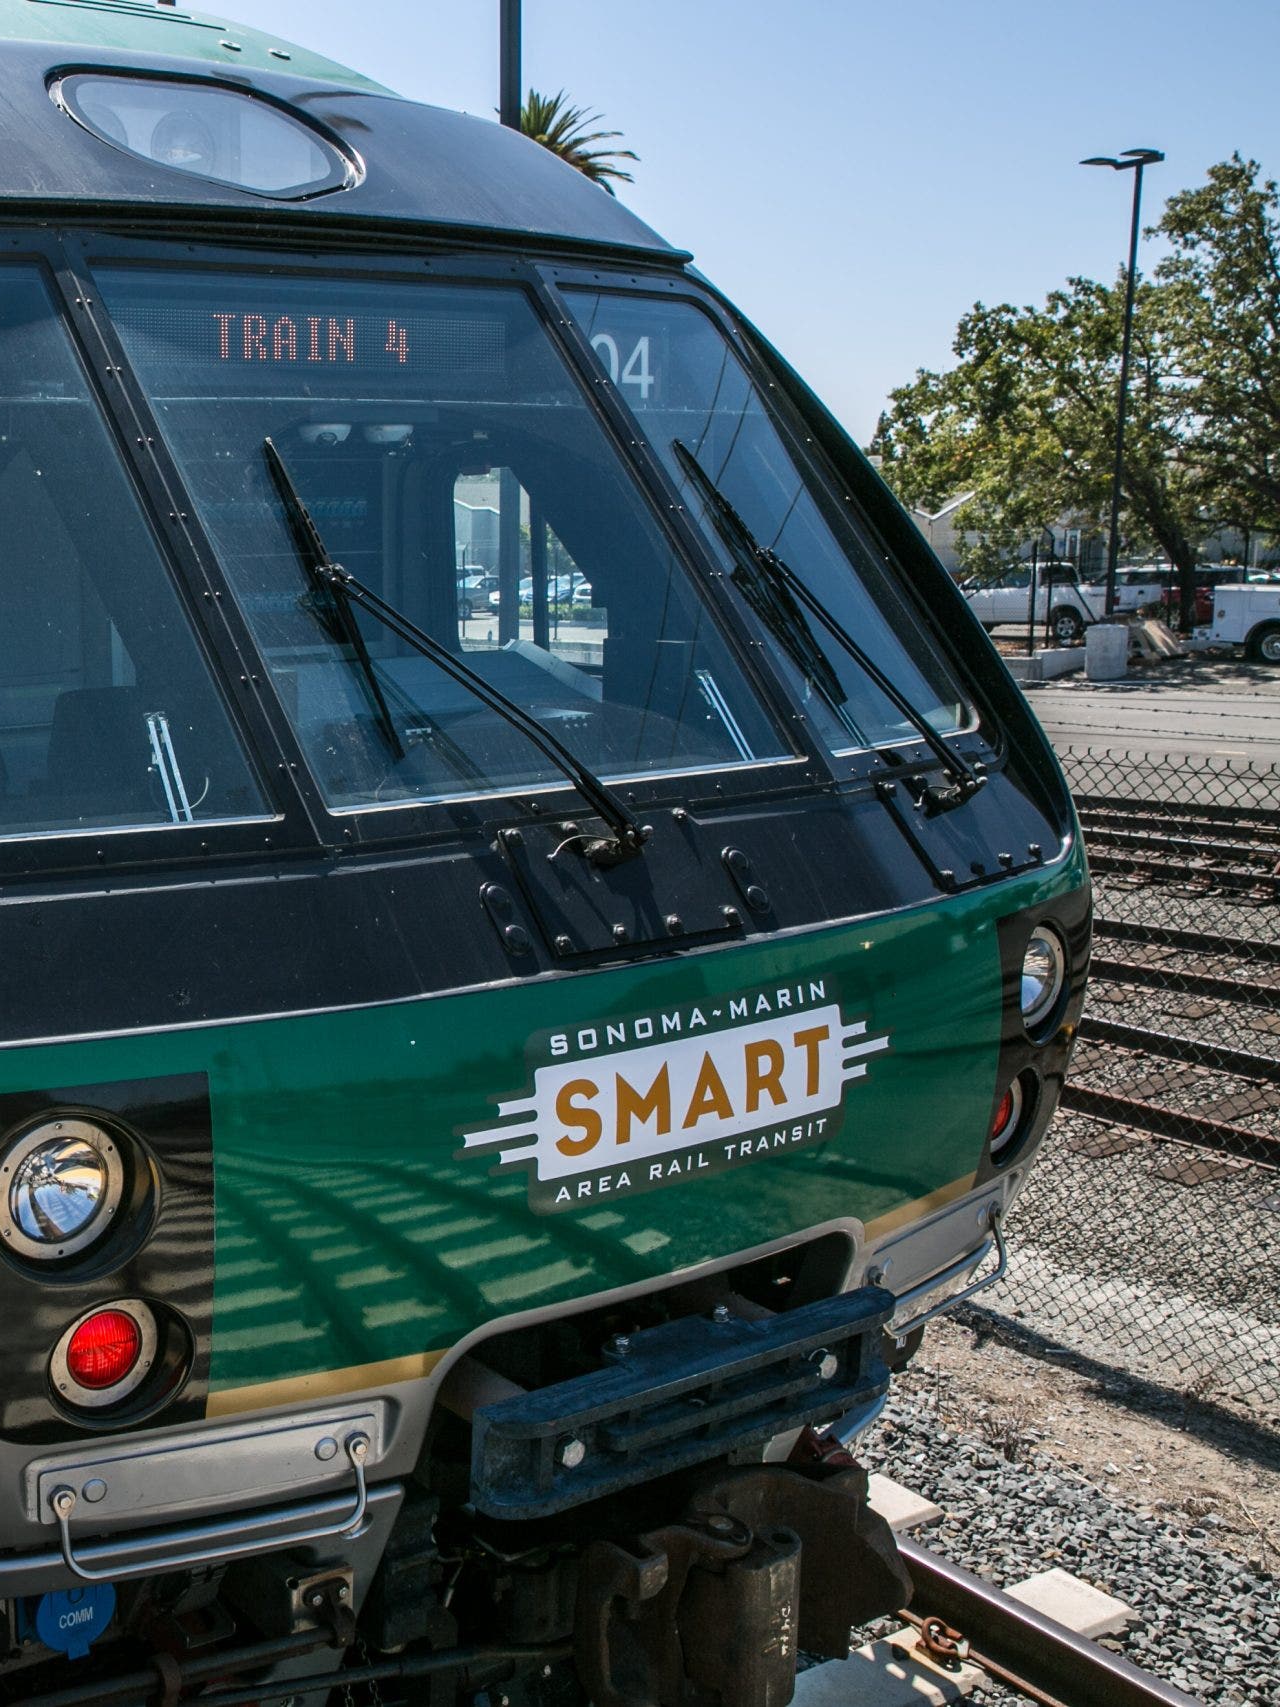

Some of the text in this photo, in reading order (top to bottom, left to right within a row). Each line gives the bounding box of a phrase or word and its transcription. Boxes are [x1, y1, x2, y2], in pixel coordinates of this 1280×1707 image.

[213, 313, 411, 363] TRAIN 4
[555, 1024, 830, 1157] SMART
[555, 1118, 828, 1203] AREA RAIL TRANSIT
[59, 1606, 93, 1629] COMM
